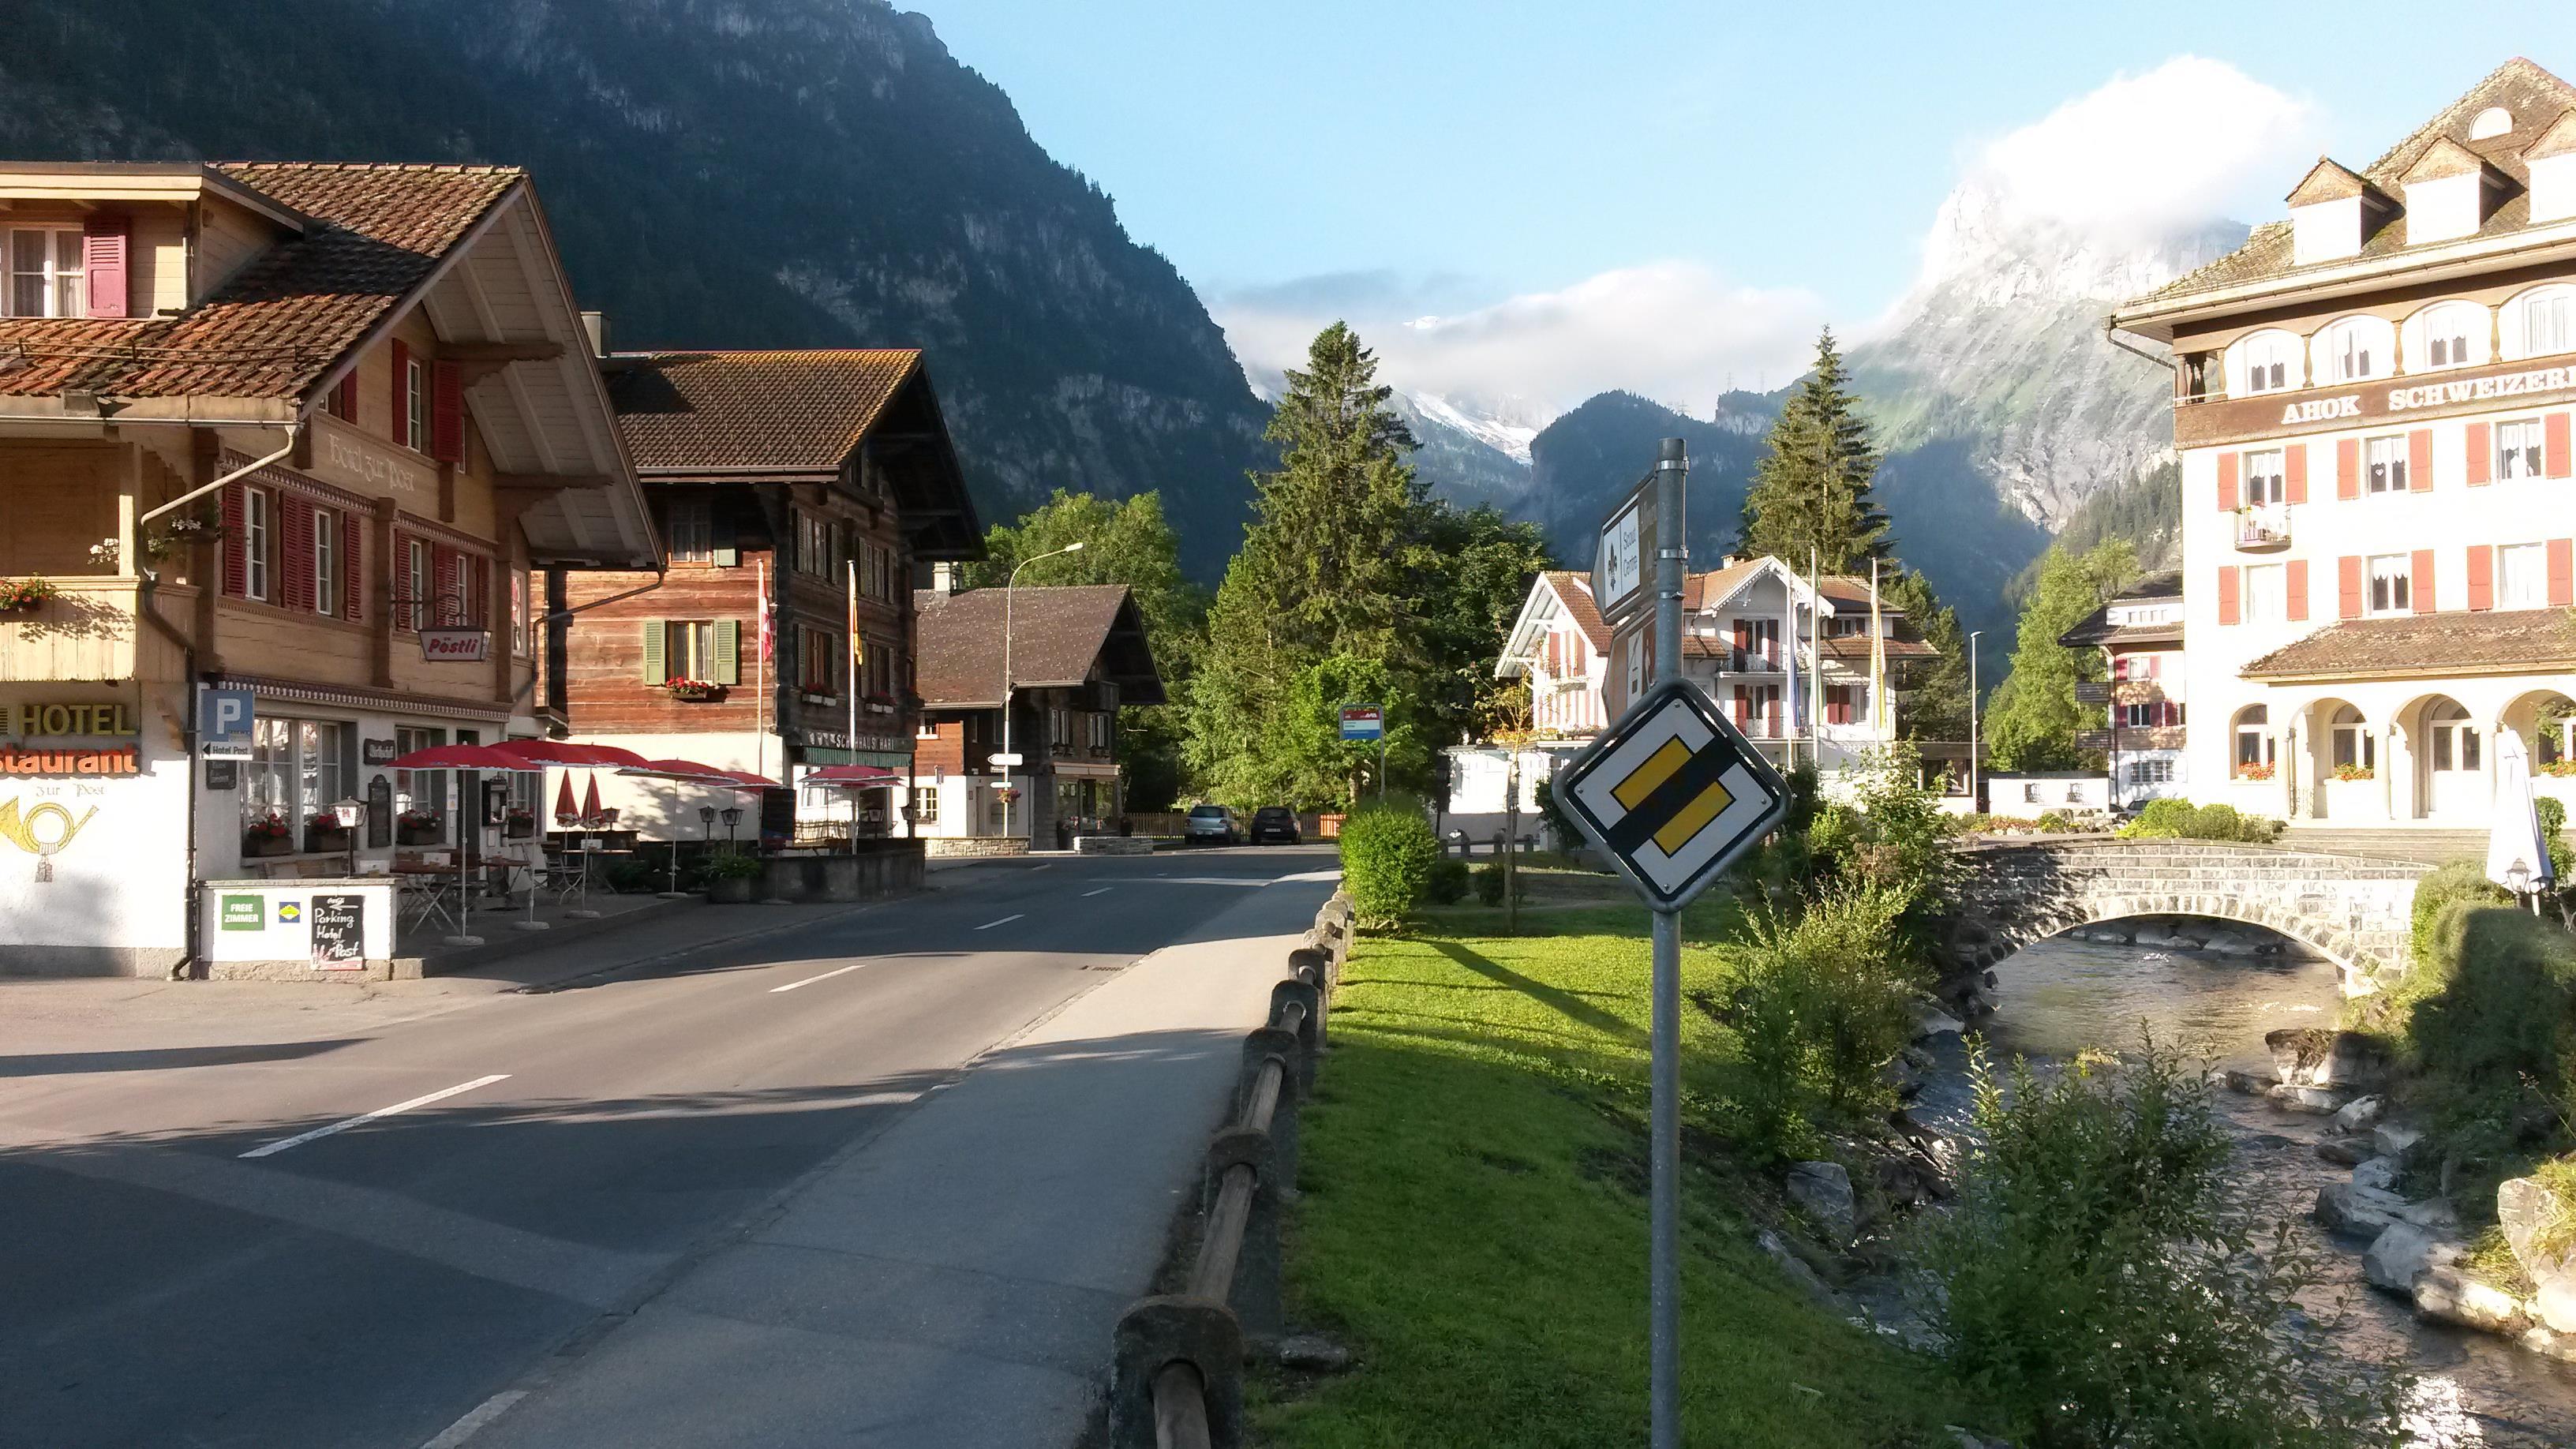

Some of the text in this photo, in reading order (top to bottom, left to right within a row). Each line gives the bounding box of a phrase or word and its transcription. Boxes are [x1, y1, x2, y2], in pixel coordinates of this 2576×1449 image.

[2281, 395, 2361, 425] AHOK
[1623, 526, 1637, 550] Scout
[1623, 554, 1638, 577] Centre
[429, 637, 478, 653] Pöstli
[18, 704, 136, 736] HOTEL
[216, 698, 241, 734] P
[212, 746, 249, 754] Hotel Post
[837, 734, 876, 751] SCHHHAUS
[0, 743, 139, 773] taurant
[230, 904, 253, 912] FREIE
[224, 914, 259, 923] ZIMMER
[315, 908, 355, 928] Parking
[316, 925, 343, 939] Hotel
[335, 941, 359, 958] Post
